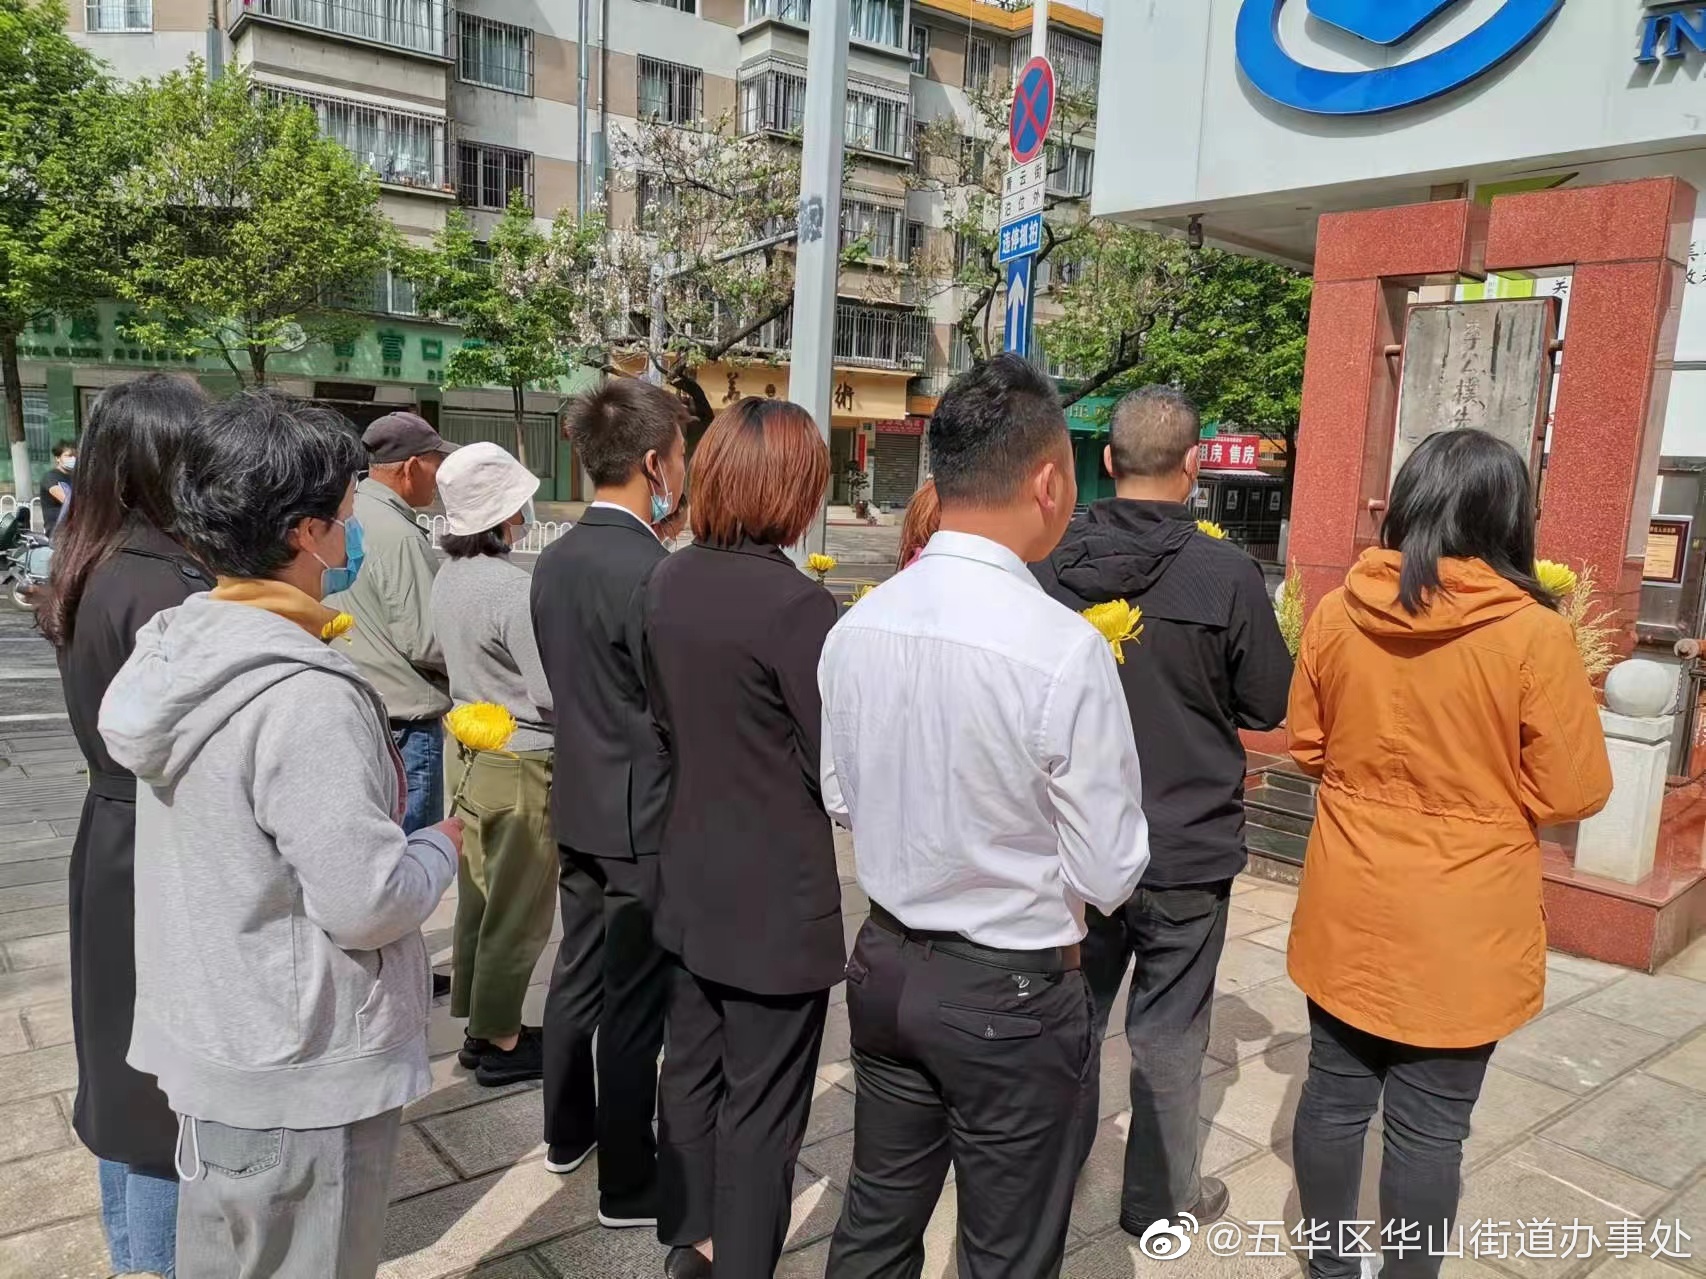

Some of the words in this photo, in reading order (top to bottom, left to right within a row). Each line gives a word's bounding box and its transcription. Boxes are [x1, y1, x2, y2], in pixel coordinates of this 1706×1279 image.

[1006, 162, 1042, 193] 青云街
[1004, 189, 1040, 217] 泊位外
[1002, 219, 1039, 254] 违停抓拍
